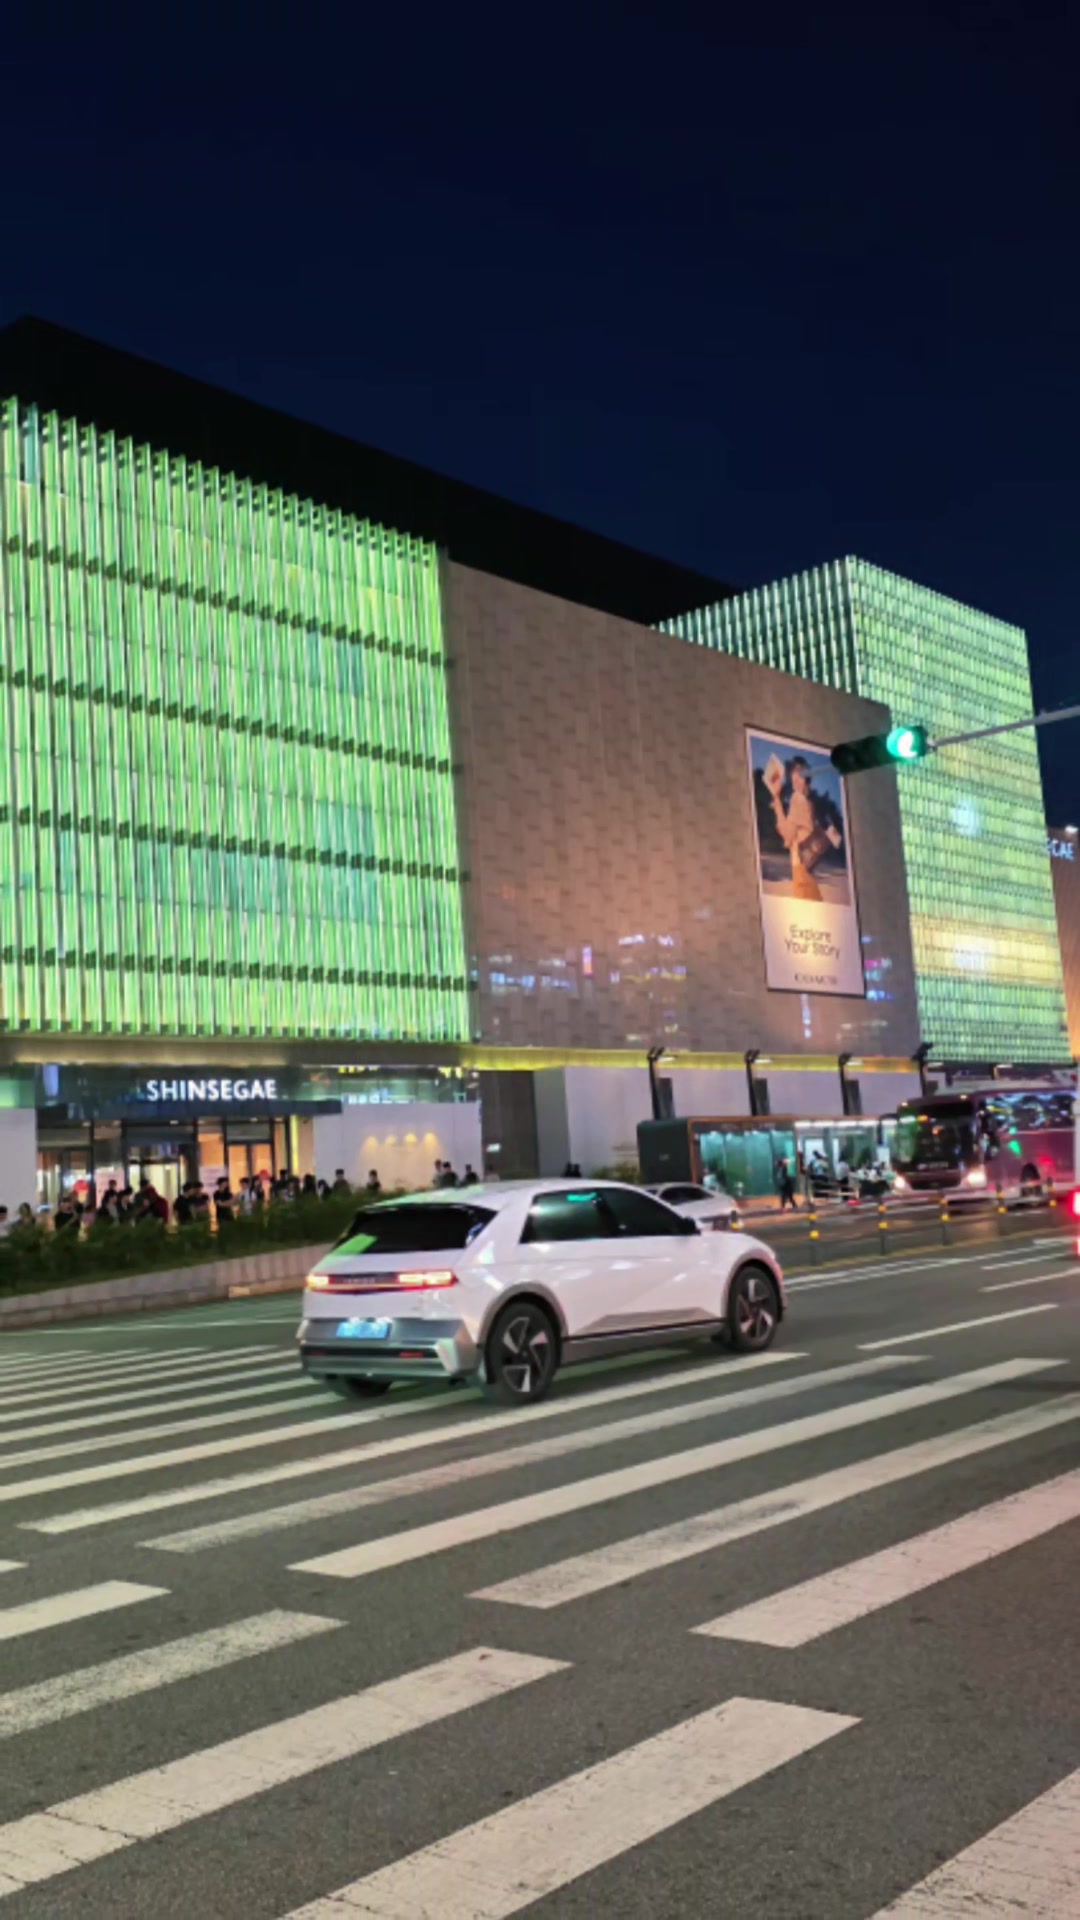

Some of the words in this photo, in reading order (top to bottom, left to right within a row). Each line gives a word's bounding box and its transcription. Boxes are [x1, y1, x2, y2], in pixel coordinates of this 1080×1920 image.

[789, 924, 832, 943] Explore
[784, 937, 809, 954] Your
[812, 942, 840, 960] Story
[146, 1078, 278, 1102] SHINSEGAE
